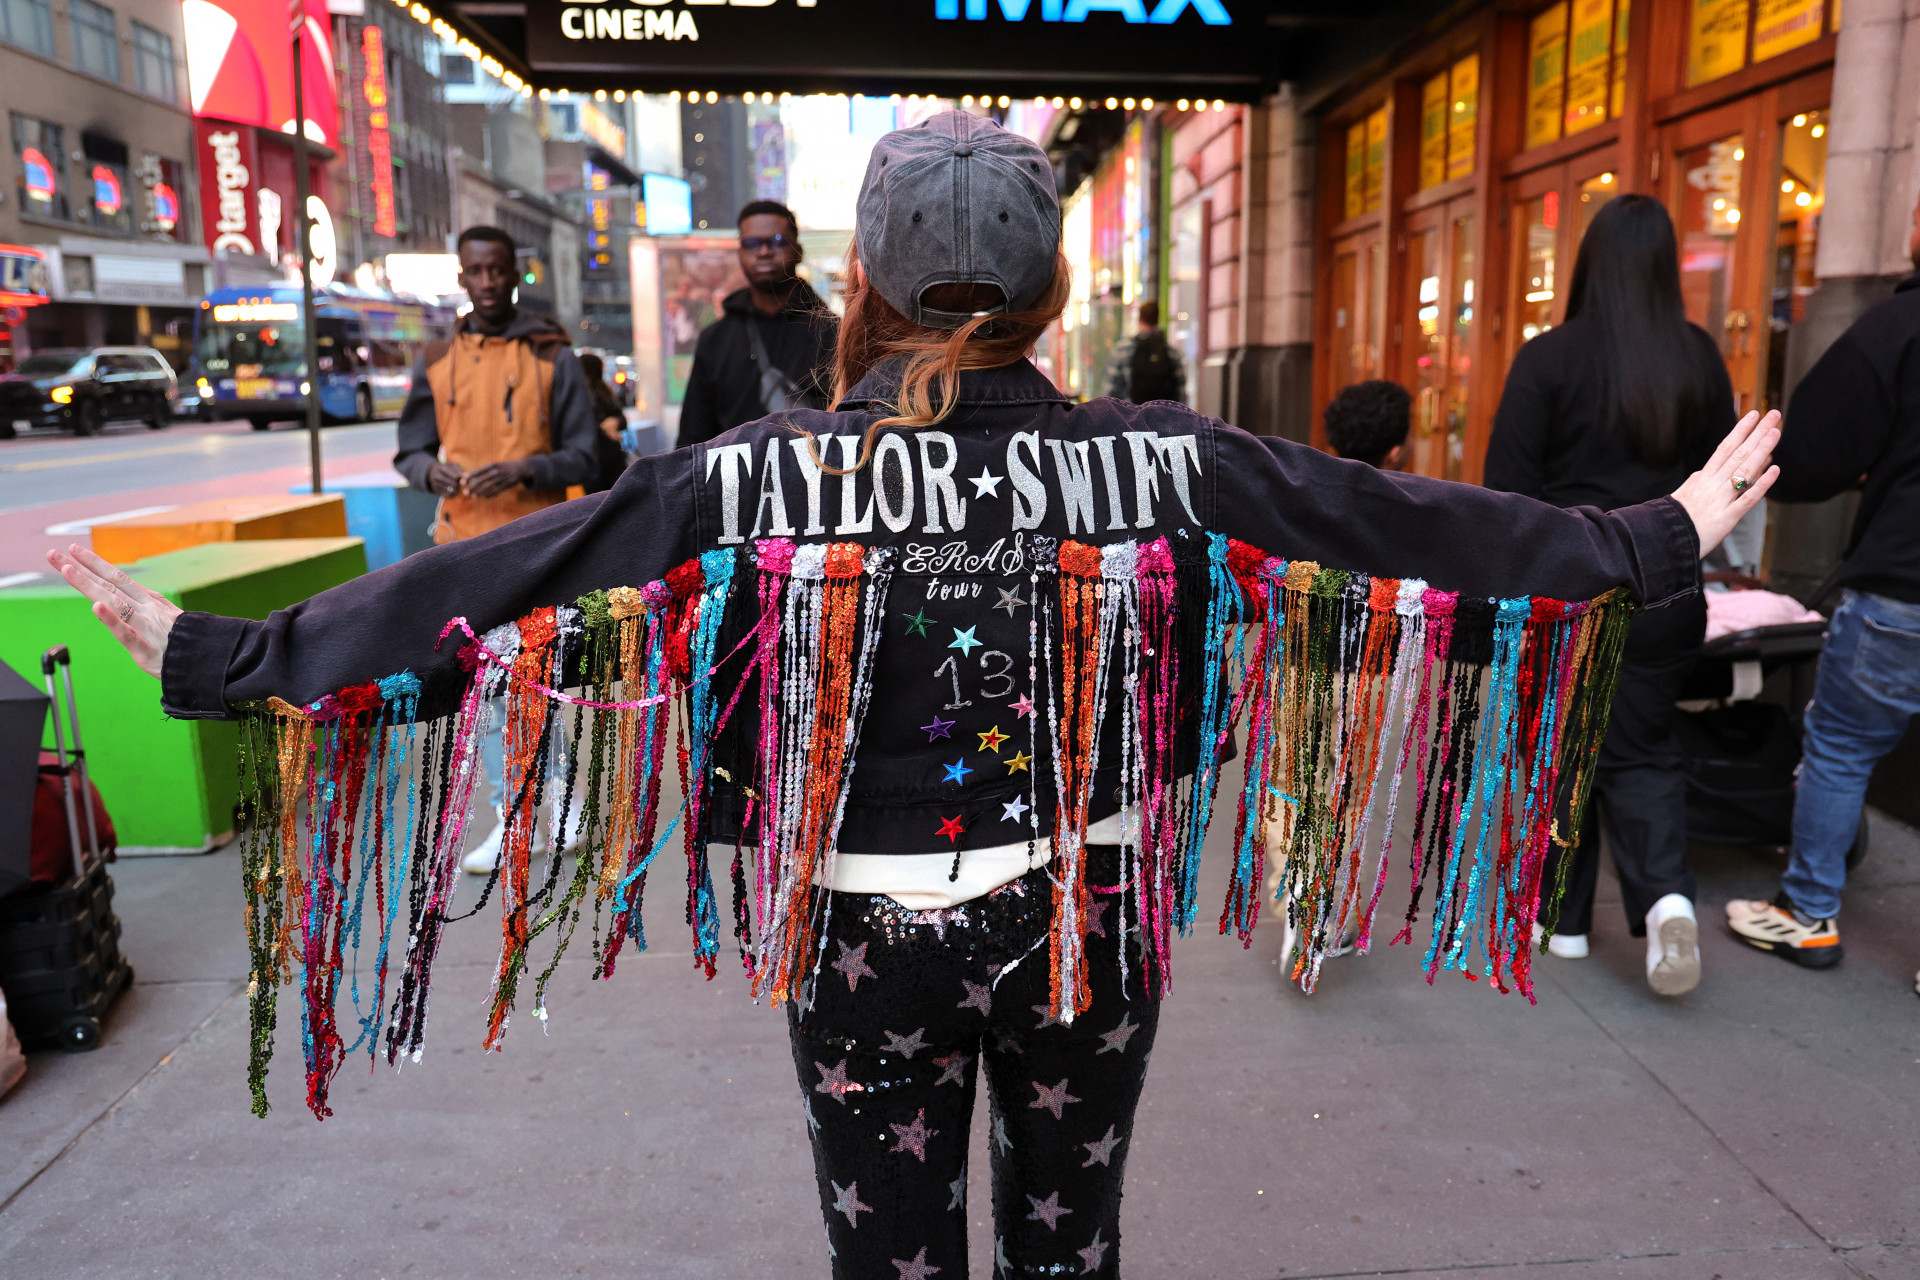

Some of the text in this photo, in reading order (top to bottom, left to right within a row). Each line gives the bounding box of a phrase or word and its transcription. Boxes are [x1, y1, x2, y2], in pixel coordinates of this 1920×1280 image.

[560, 8, 699, 41] CINEMA
[705, 429, 1203, 545] TAYLOR SWIFT
[902, 531, 1024, 577] ERAS
[926, 577, 983, 601] tour
[934, 650, 1016, 711] 13
